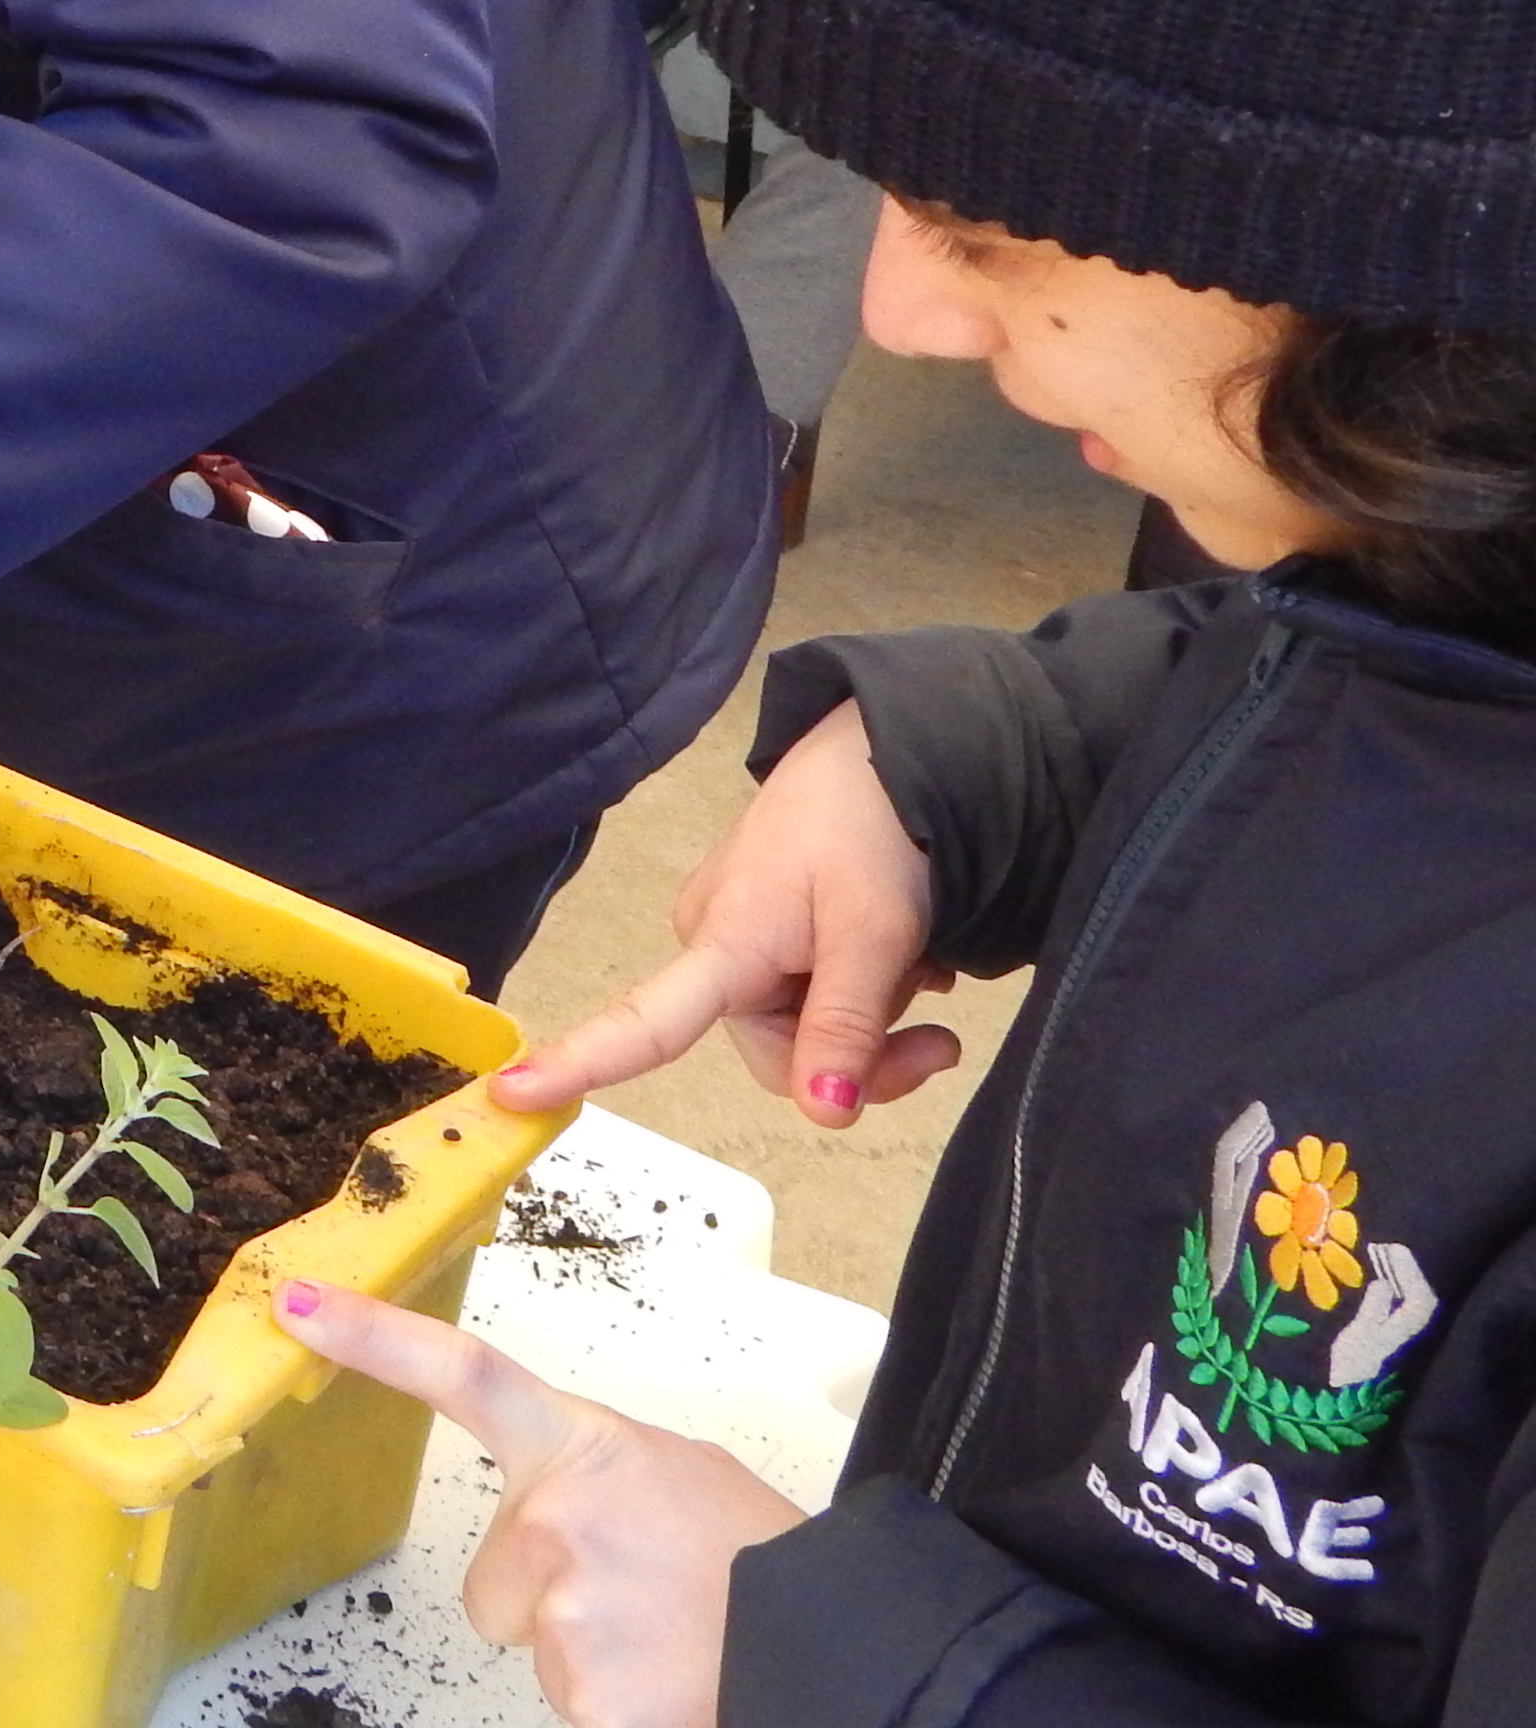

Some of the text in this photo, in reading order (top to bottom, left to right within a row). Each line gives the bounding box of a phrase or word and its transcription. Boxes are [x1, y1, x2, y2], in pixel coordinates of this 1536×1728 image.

[1120, 1341, 1386, 1581] APAE
[1138, 1481, 1256, 1566] Carlos
[1086, 1462, 1220, 1581] Barbosa
[1255, 1582, 1315, 1630] RS
